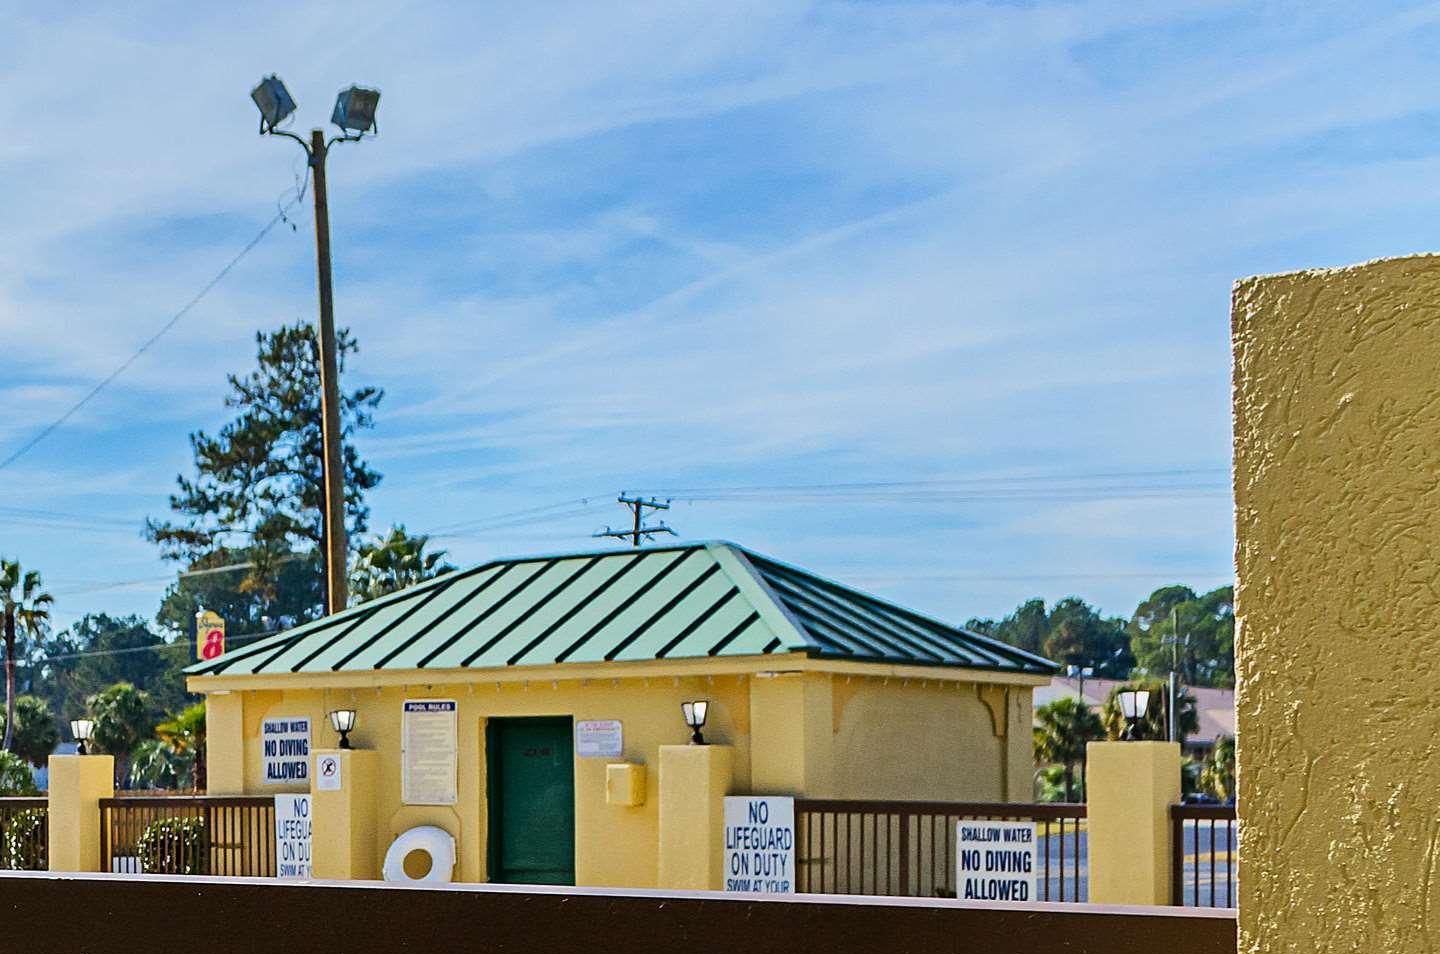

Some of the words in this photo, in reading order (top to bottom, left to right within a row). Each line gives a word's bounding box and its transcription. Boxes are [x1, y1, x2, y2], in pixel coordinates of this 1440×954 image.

[203, 630, 223, 659] 8
[408, 703, 426, 711] POOL
[264, 722, 288, 734] SHALLOW
[290, 721, 308, 732] WATER
[265, 740, 277, 757] NO
[279, 739, 308, 756] DIVING
[267, 762, 307, 779] ALLOWED
[294, 799, 308, 818] NO
[749, 801, 768, 824] NO
[278, 820, 312, 840] LIFEGUA
[726, 827, 792, 850] LIFEGUARD
[961, 826, 1000, 842] SHALLOW
[1003, 828, 1032, 843] WATER
[283, 842, 295, 861] ON
[299, 842, 310, 862] DU
[961, 850, 980, 871] NO
[985, 850, 1032, 873] DIVING
[280, 864, 296, 877] SWIM
[298, 865, 304, 877] AT
[731, 852, 749, 875] ON
[754, 853, 787, 877] DUTY
[727, 879, 750, 892] SWIM
[753, 880, 763, 892] AT
[766, 881, 789, 893] YOUR
[964, 878, 1028, 902] ALLOWED
